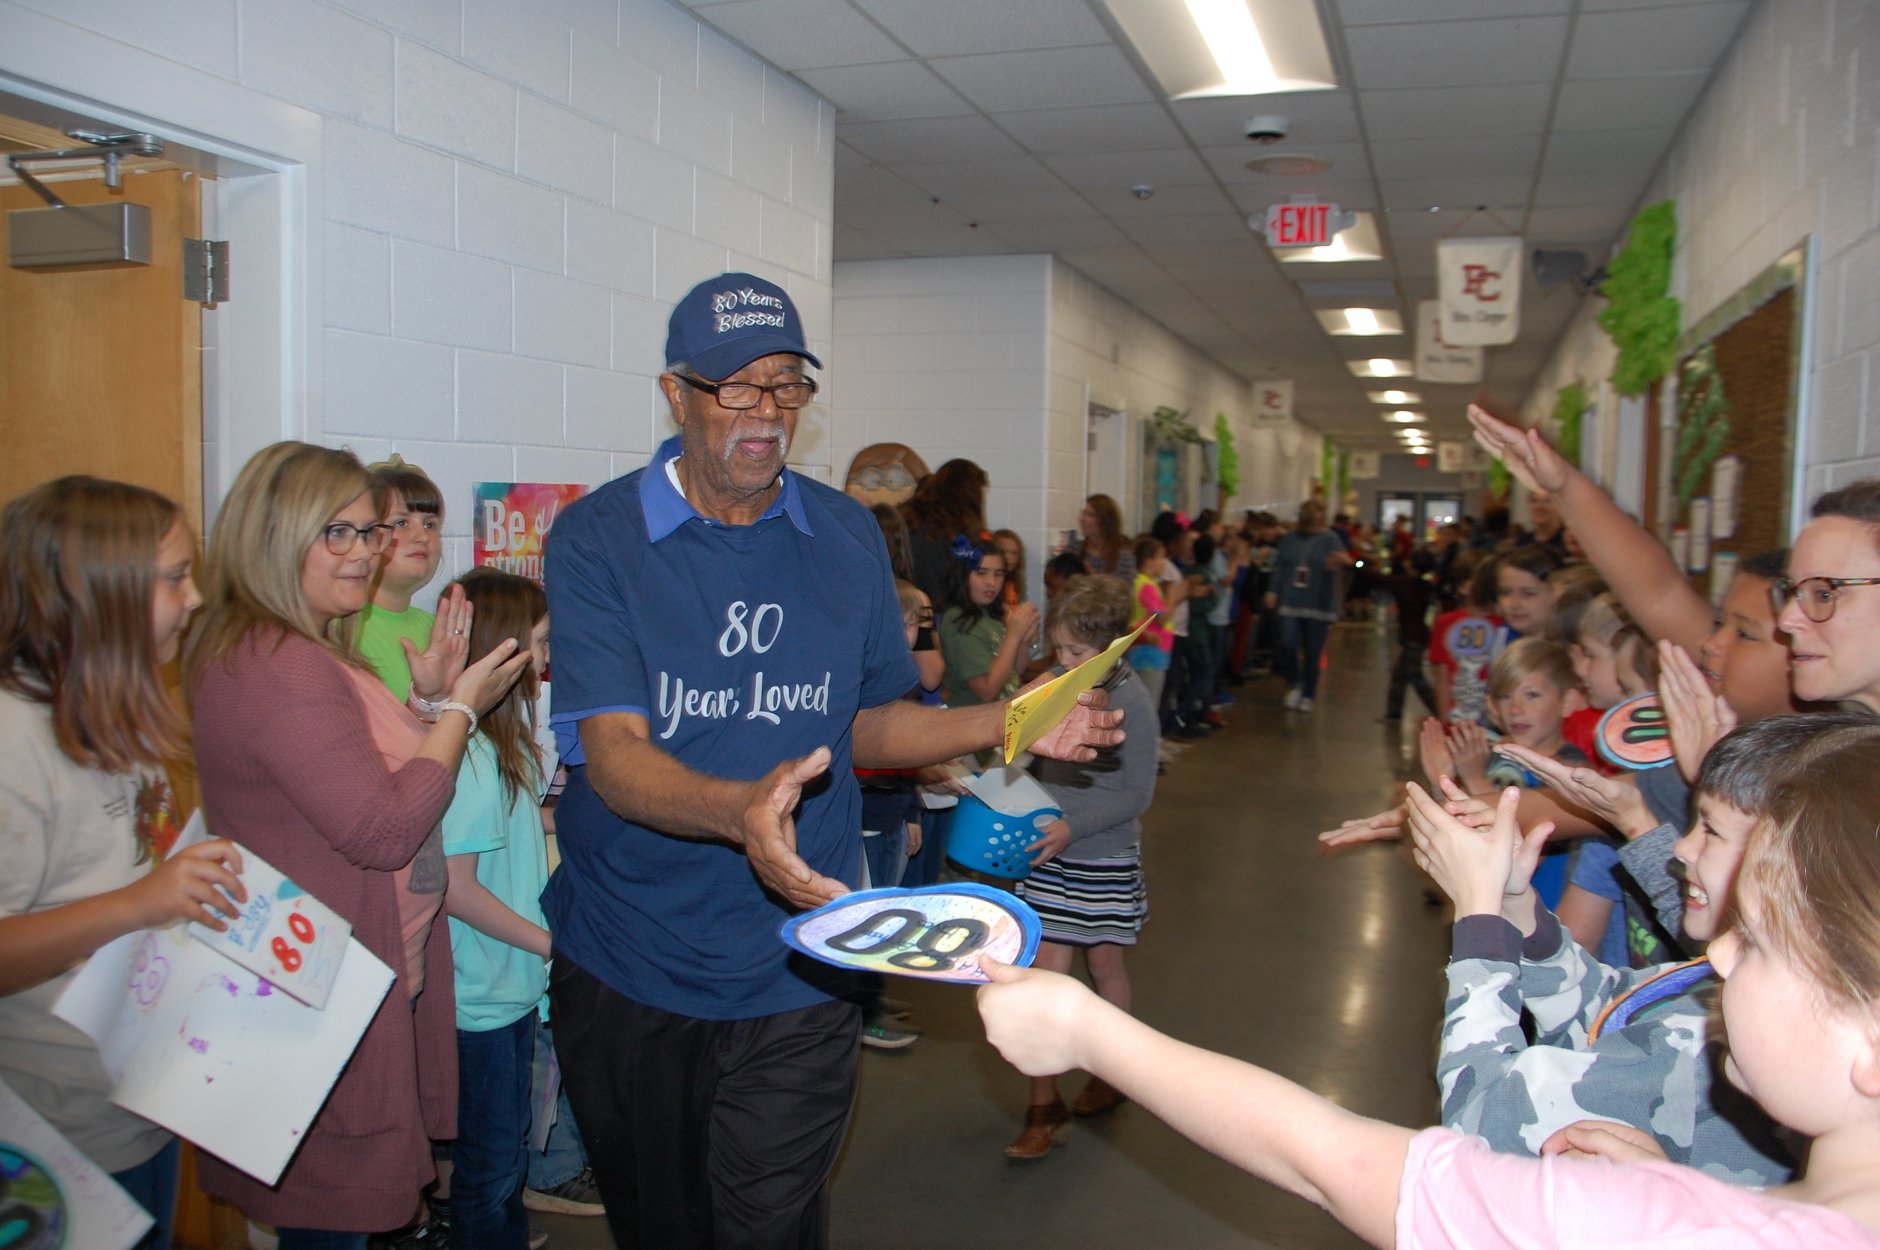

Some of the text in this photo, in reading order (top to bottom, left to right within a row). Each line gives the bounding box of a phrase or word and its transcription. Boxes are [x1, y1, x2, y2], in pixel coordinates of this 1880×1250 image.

[1279, 205, 1329, 243] EXIT
[711, 287, 783, 313] 80 Years
[1463, 264, 1501, 302] PC
[713, 312, 785, 334] Blessed
[484, 499, 526, 552] Be
[484, 552, 545, 587] stron
[718, 600, 784, 657] 80
[746, 671, 831, 725] Loved
[271, 912, 316, 974] 80
